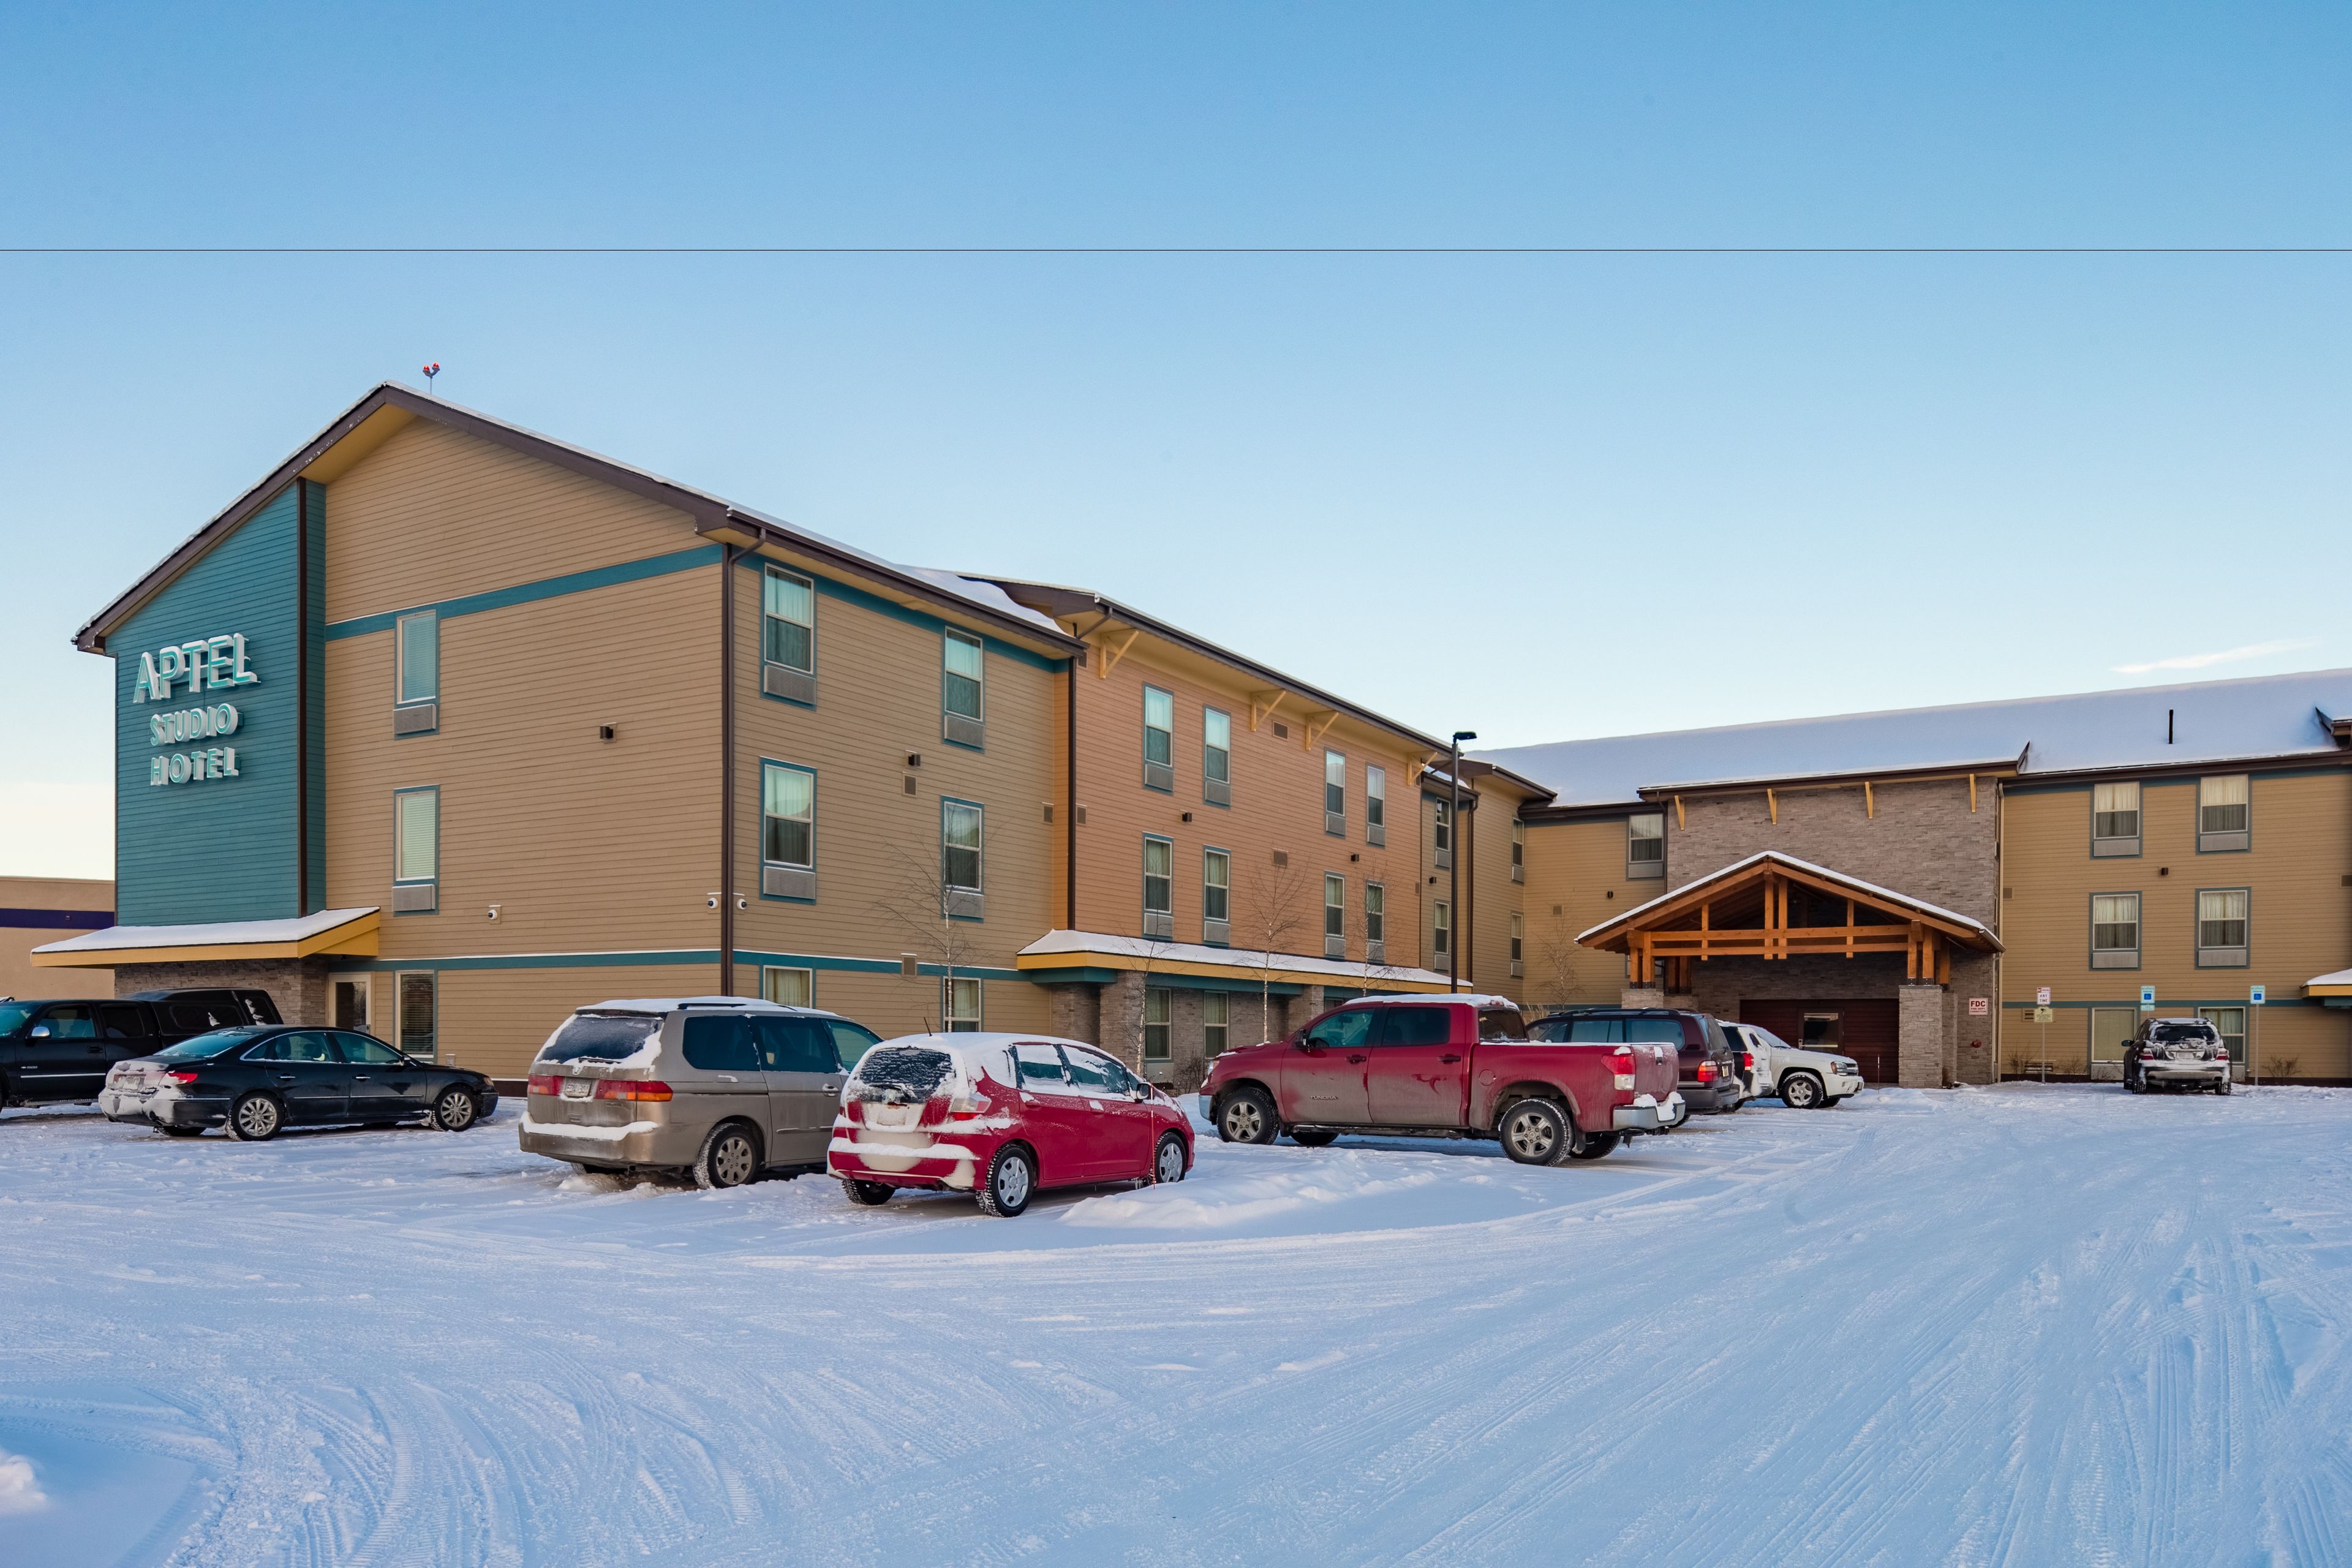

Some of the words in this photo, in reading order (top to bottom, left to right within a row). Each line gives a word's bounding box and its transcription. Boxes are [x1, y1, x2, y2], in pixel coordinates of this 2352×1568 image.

[133, 633, 257, 703] APTEL
[150, 703, 238, 746] STUDIO
[150, 747, 239, 786] HOTEL
